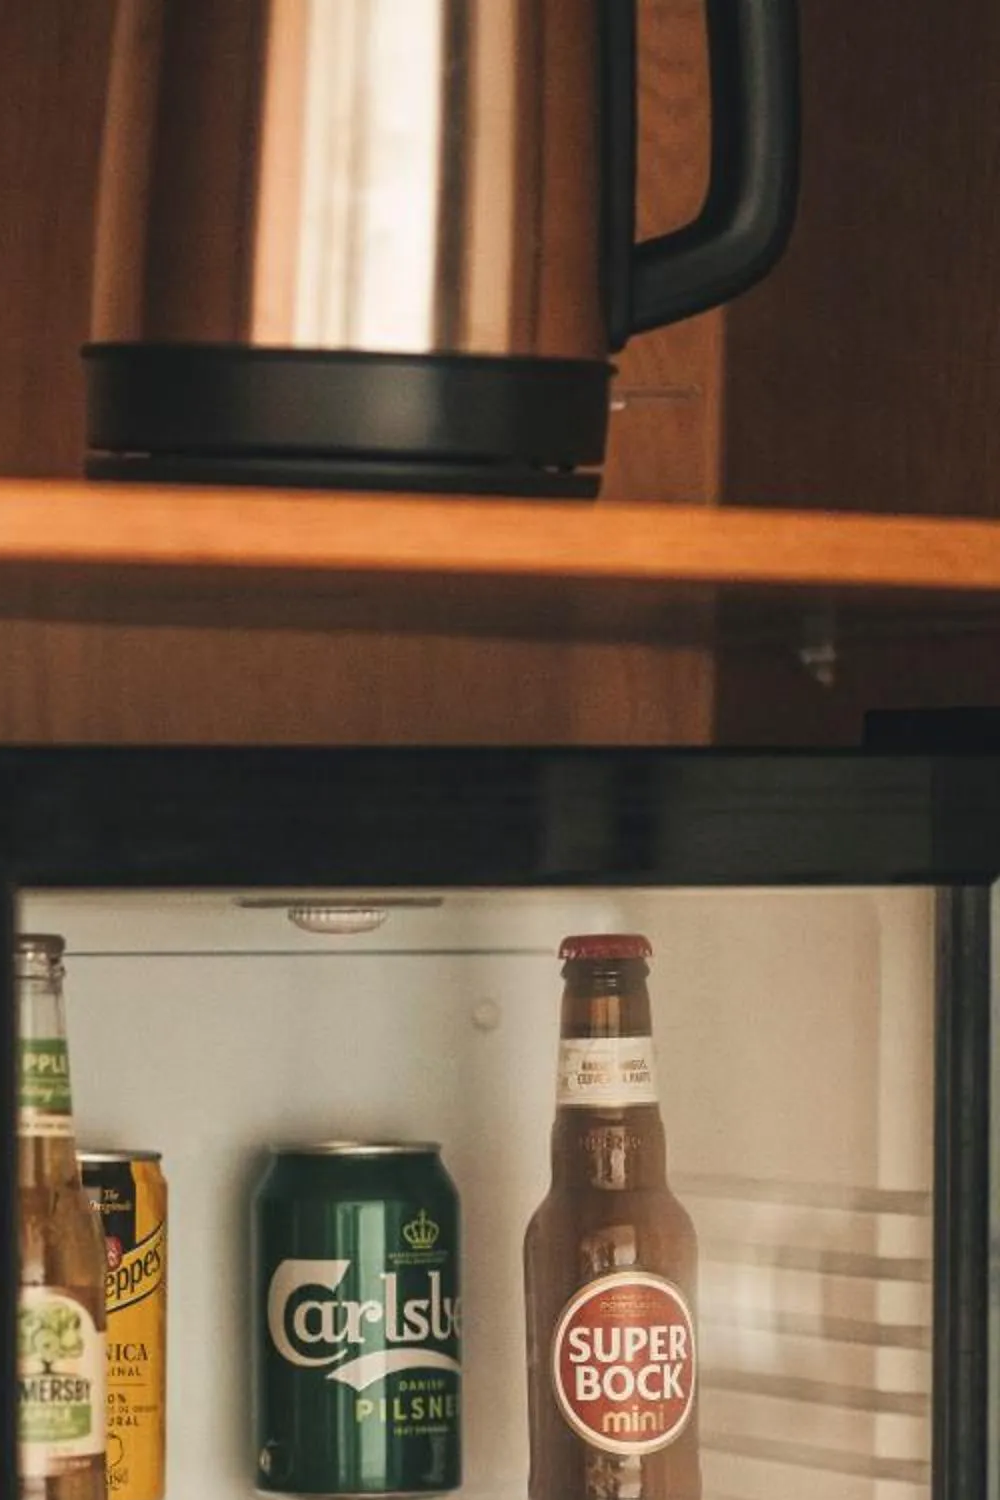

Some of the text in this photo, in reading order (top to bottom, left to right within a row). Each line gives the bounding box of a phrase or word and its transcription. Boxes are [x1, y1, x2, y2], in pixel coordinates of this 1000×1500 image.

[104, 1244, 162, 1300] eppes
[267, 1259, 462, 1368] Carlsb
[105, 1343, 149, 1361] NICA
[568, 1324, 688, 1364] SUPER
[18, 1377, 91, 1404] MERSBY
[575, 1363, 685, 1402] BOCK
[601, 1404, 665, 1433] mini
